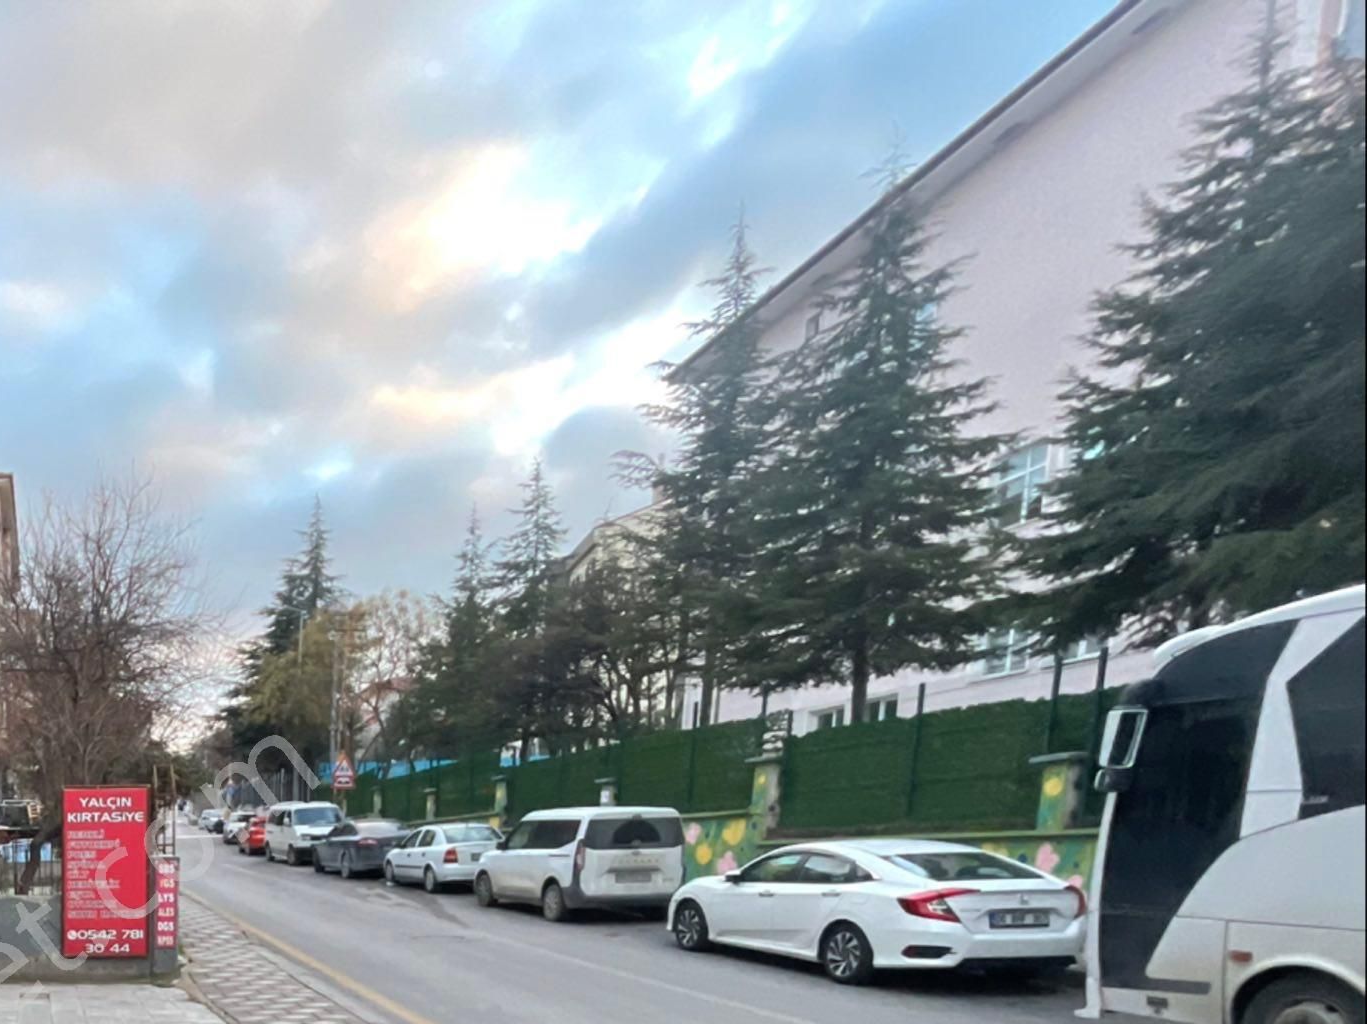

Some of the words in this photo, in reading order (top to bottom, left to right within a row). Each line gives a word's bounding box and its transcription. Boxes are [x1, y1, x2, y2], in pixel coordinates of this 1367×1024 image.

[79, 796, 132, 810] YALÇIN
[67, 811, 145, 823] KIRTASİYE
[77, 929, 117, 939] 0542
[121, 929, 144, 939] 781
[85, 943, 105, 953] 30
[109, 943, 130, 953] 44
